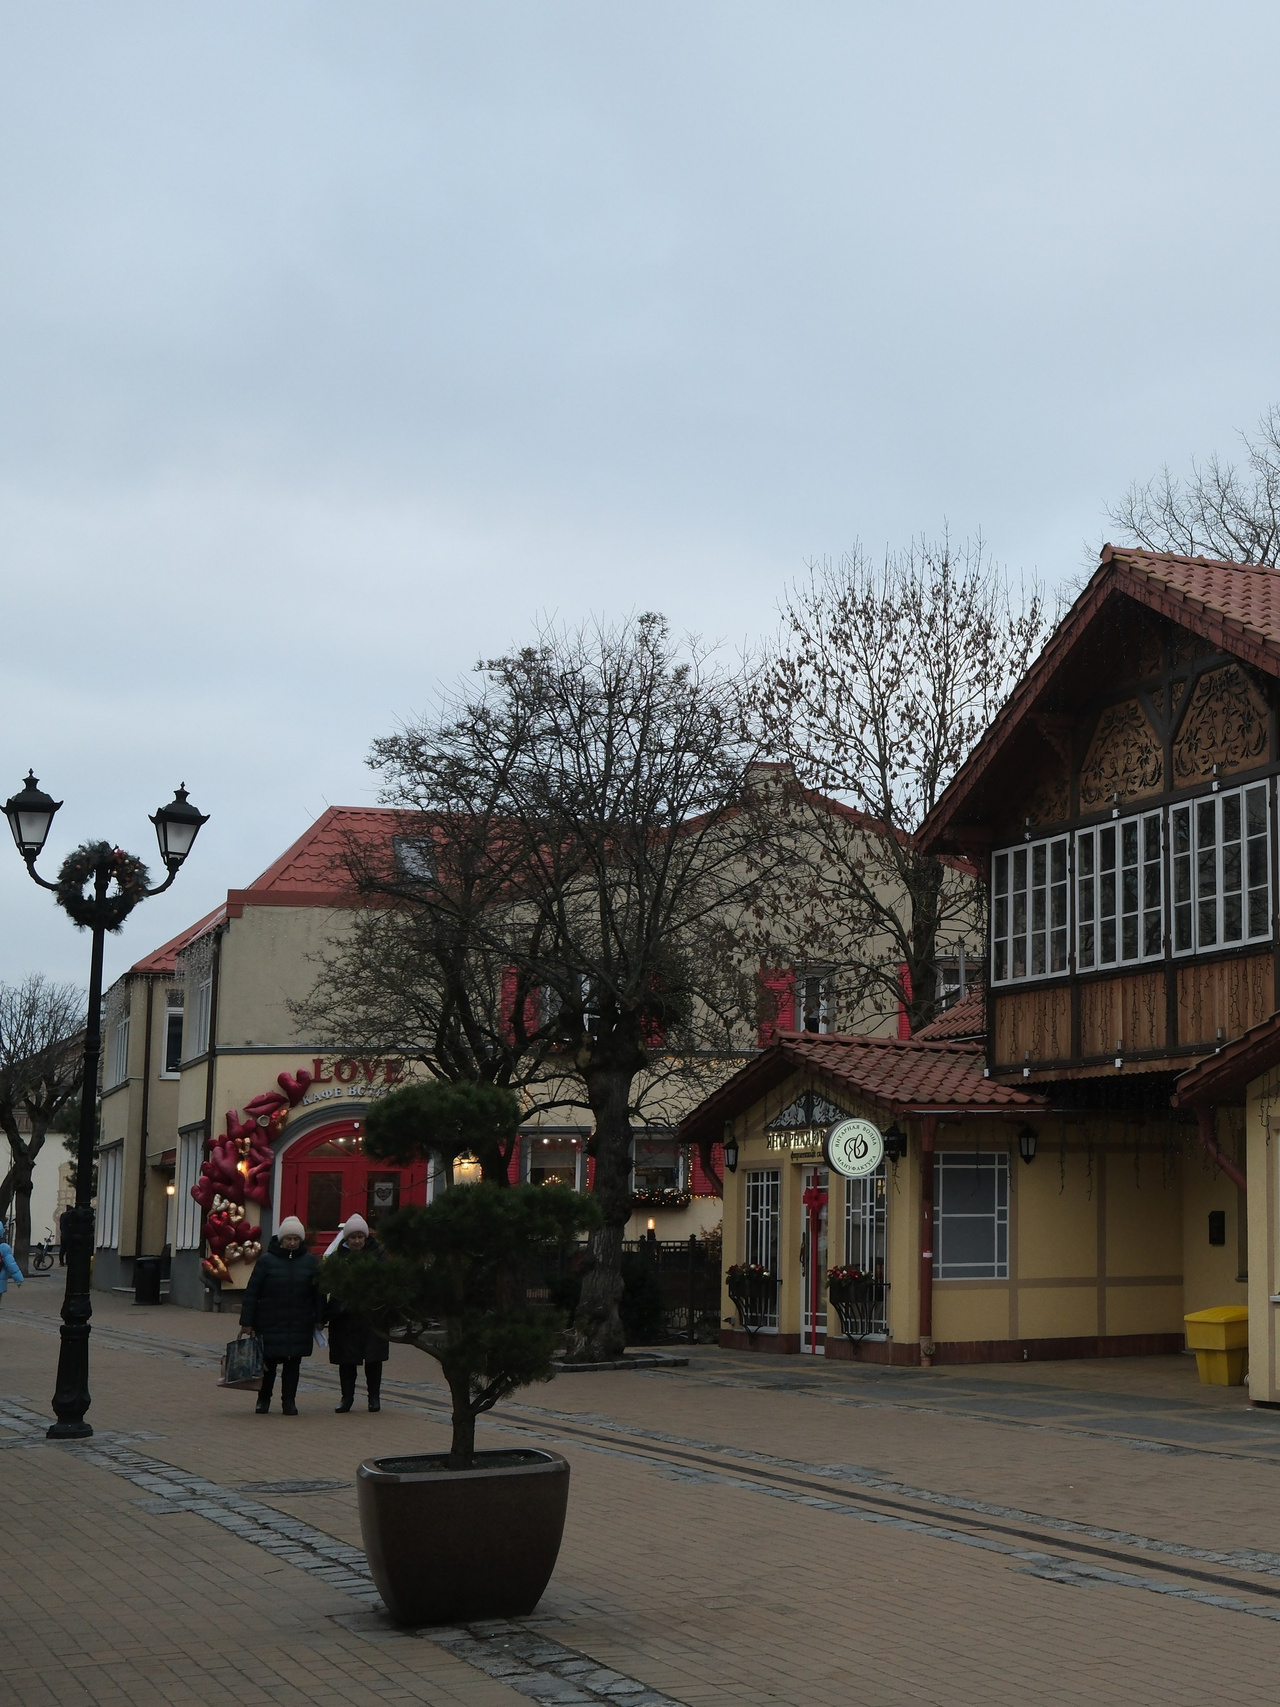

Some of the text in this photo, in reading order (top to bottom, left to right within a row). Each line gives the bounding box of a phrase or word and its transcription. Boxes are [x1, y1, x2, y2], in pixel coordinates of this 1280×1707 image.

[311, 1058, 404, 1083] LOVE
[302, 1087, 343, 1105] КАФЕ
[766, 1131, 811, 1149] ЯНТАРНАЯ
[835, 1125, 860, 1148] ЯНТАРНАЯ
[862, 1126, 877, 1146] ВОЛНА
[837, 1155, 877, 1171] МАНУФАКТУРА
